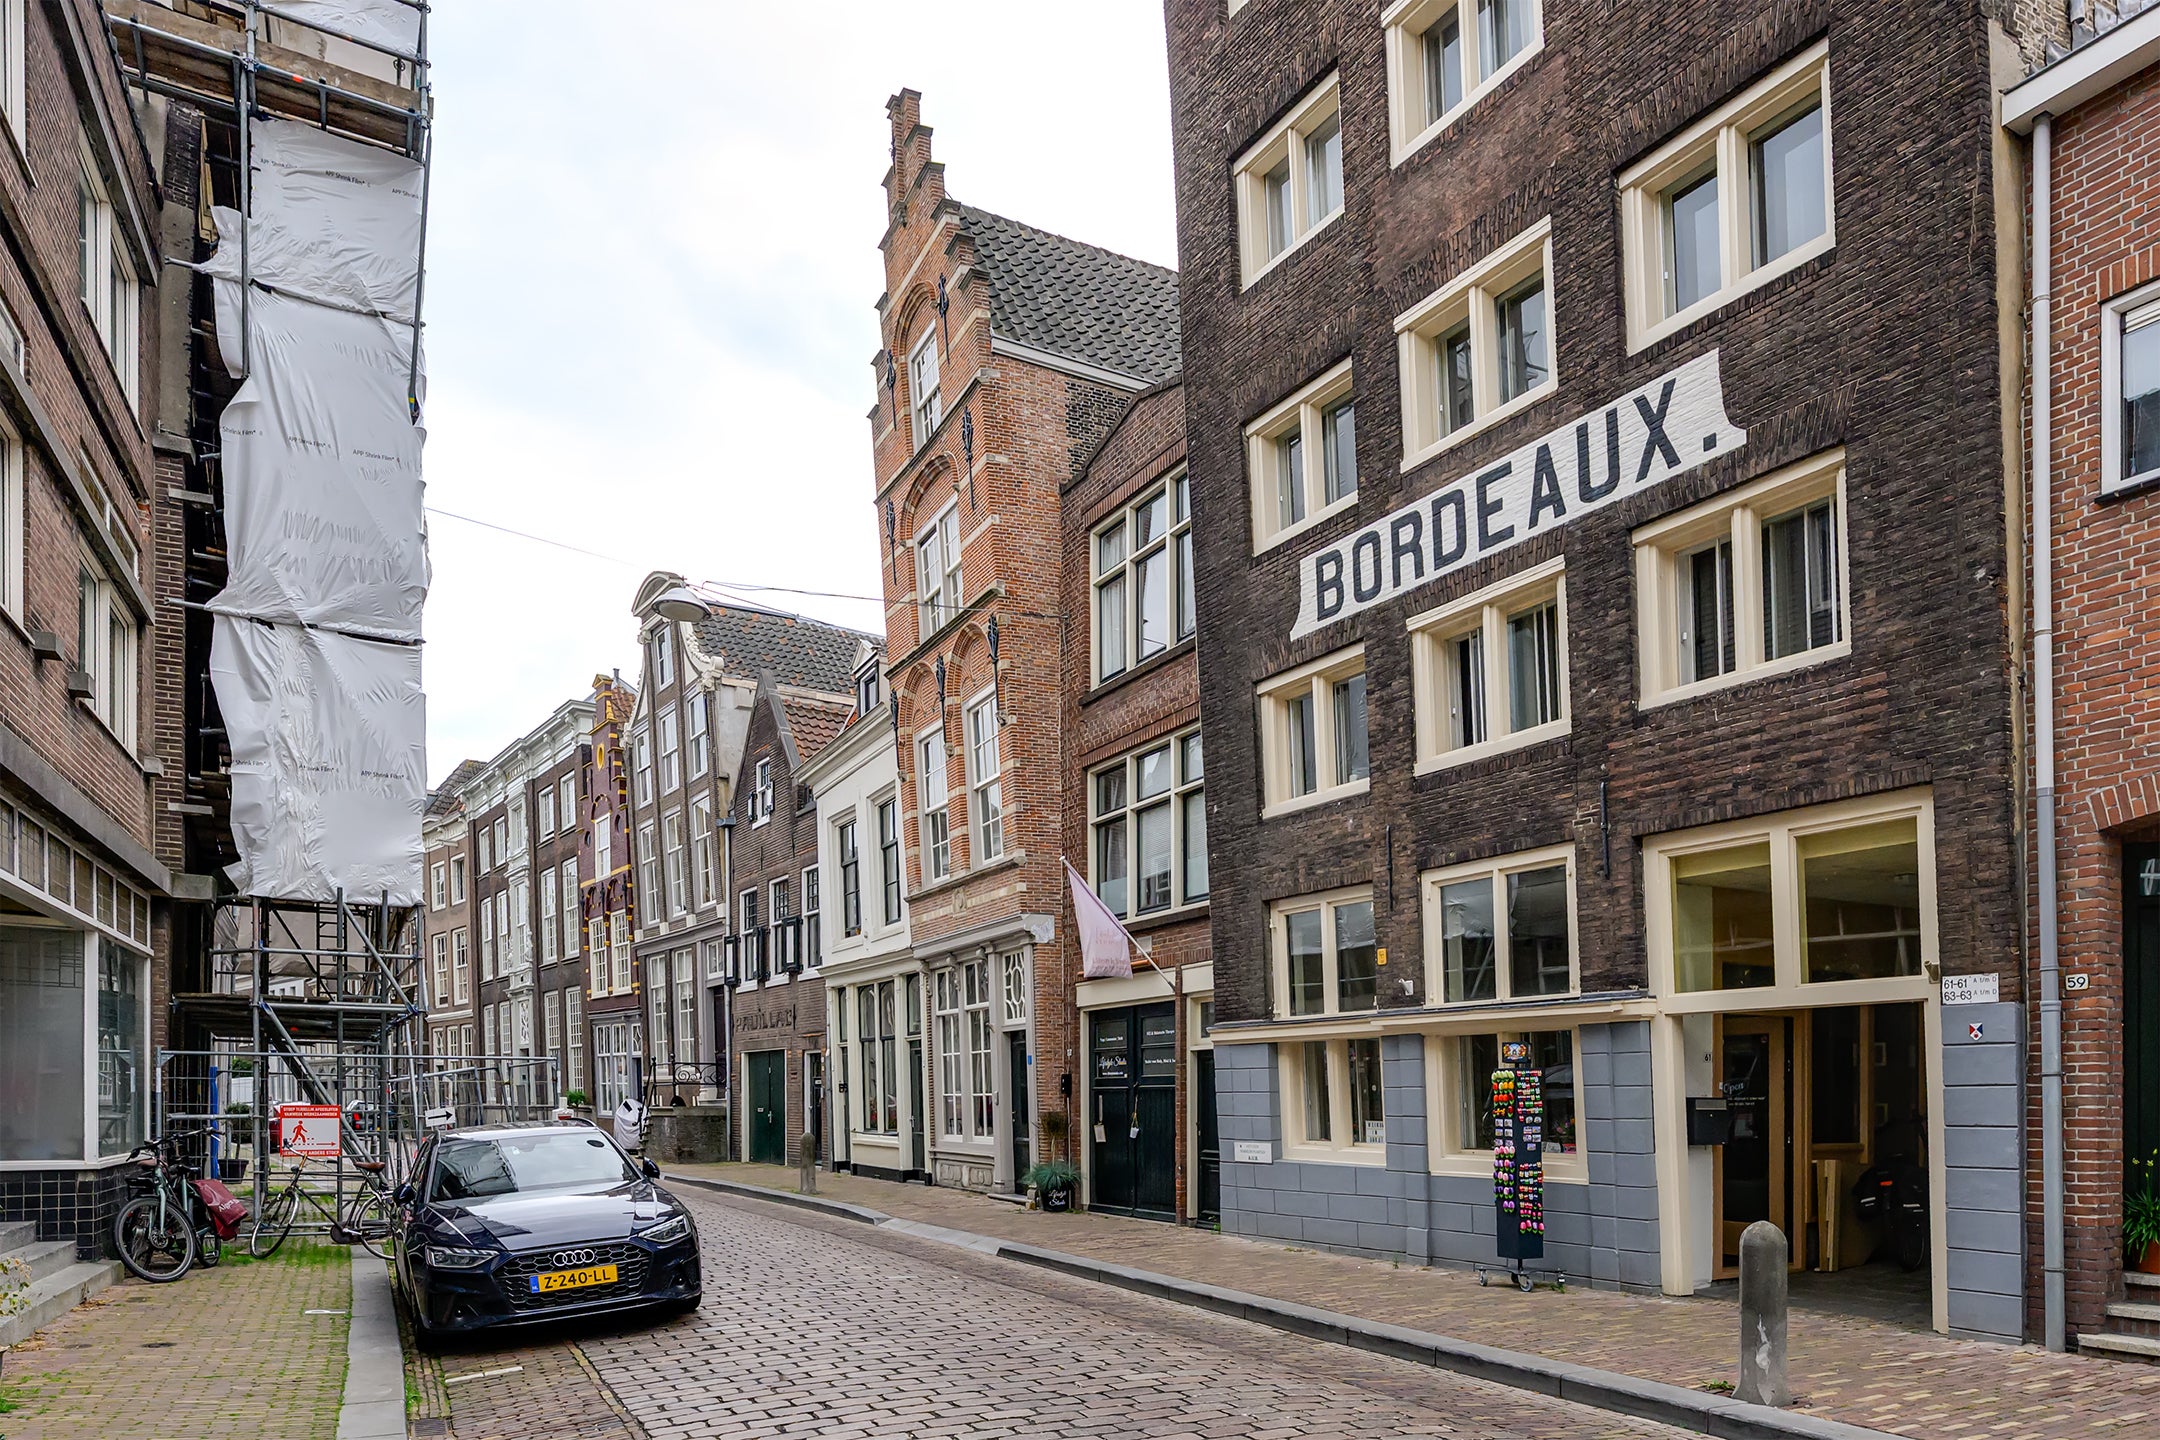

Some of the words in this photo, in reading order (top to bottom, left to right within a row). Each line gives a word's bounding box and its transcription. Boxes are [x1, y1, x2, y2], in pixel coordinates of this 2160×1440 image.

[352, 448, 365, 457] APP
[365, 450, 381, 460] Shrink
[1316, 377, 1718, 622] BORDEAUX.
[1943, 978, 1968, 990] 61-61
[2067, 976, 2086, 989] 59
[1943, 990, 1973, 1001] 63-63
[544, 1269, 611, 1289] Z-240-LL
